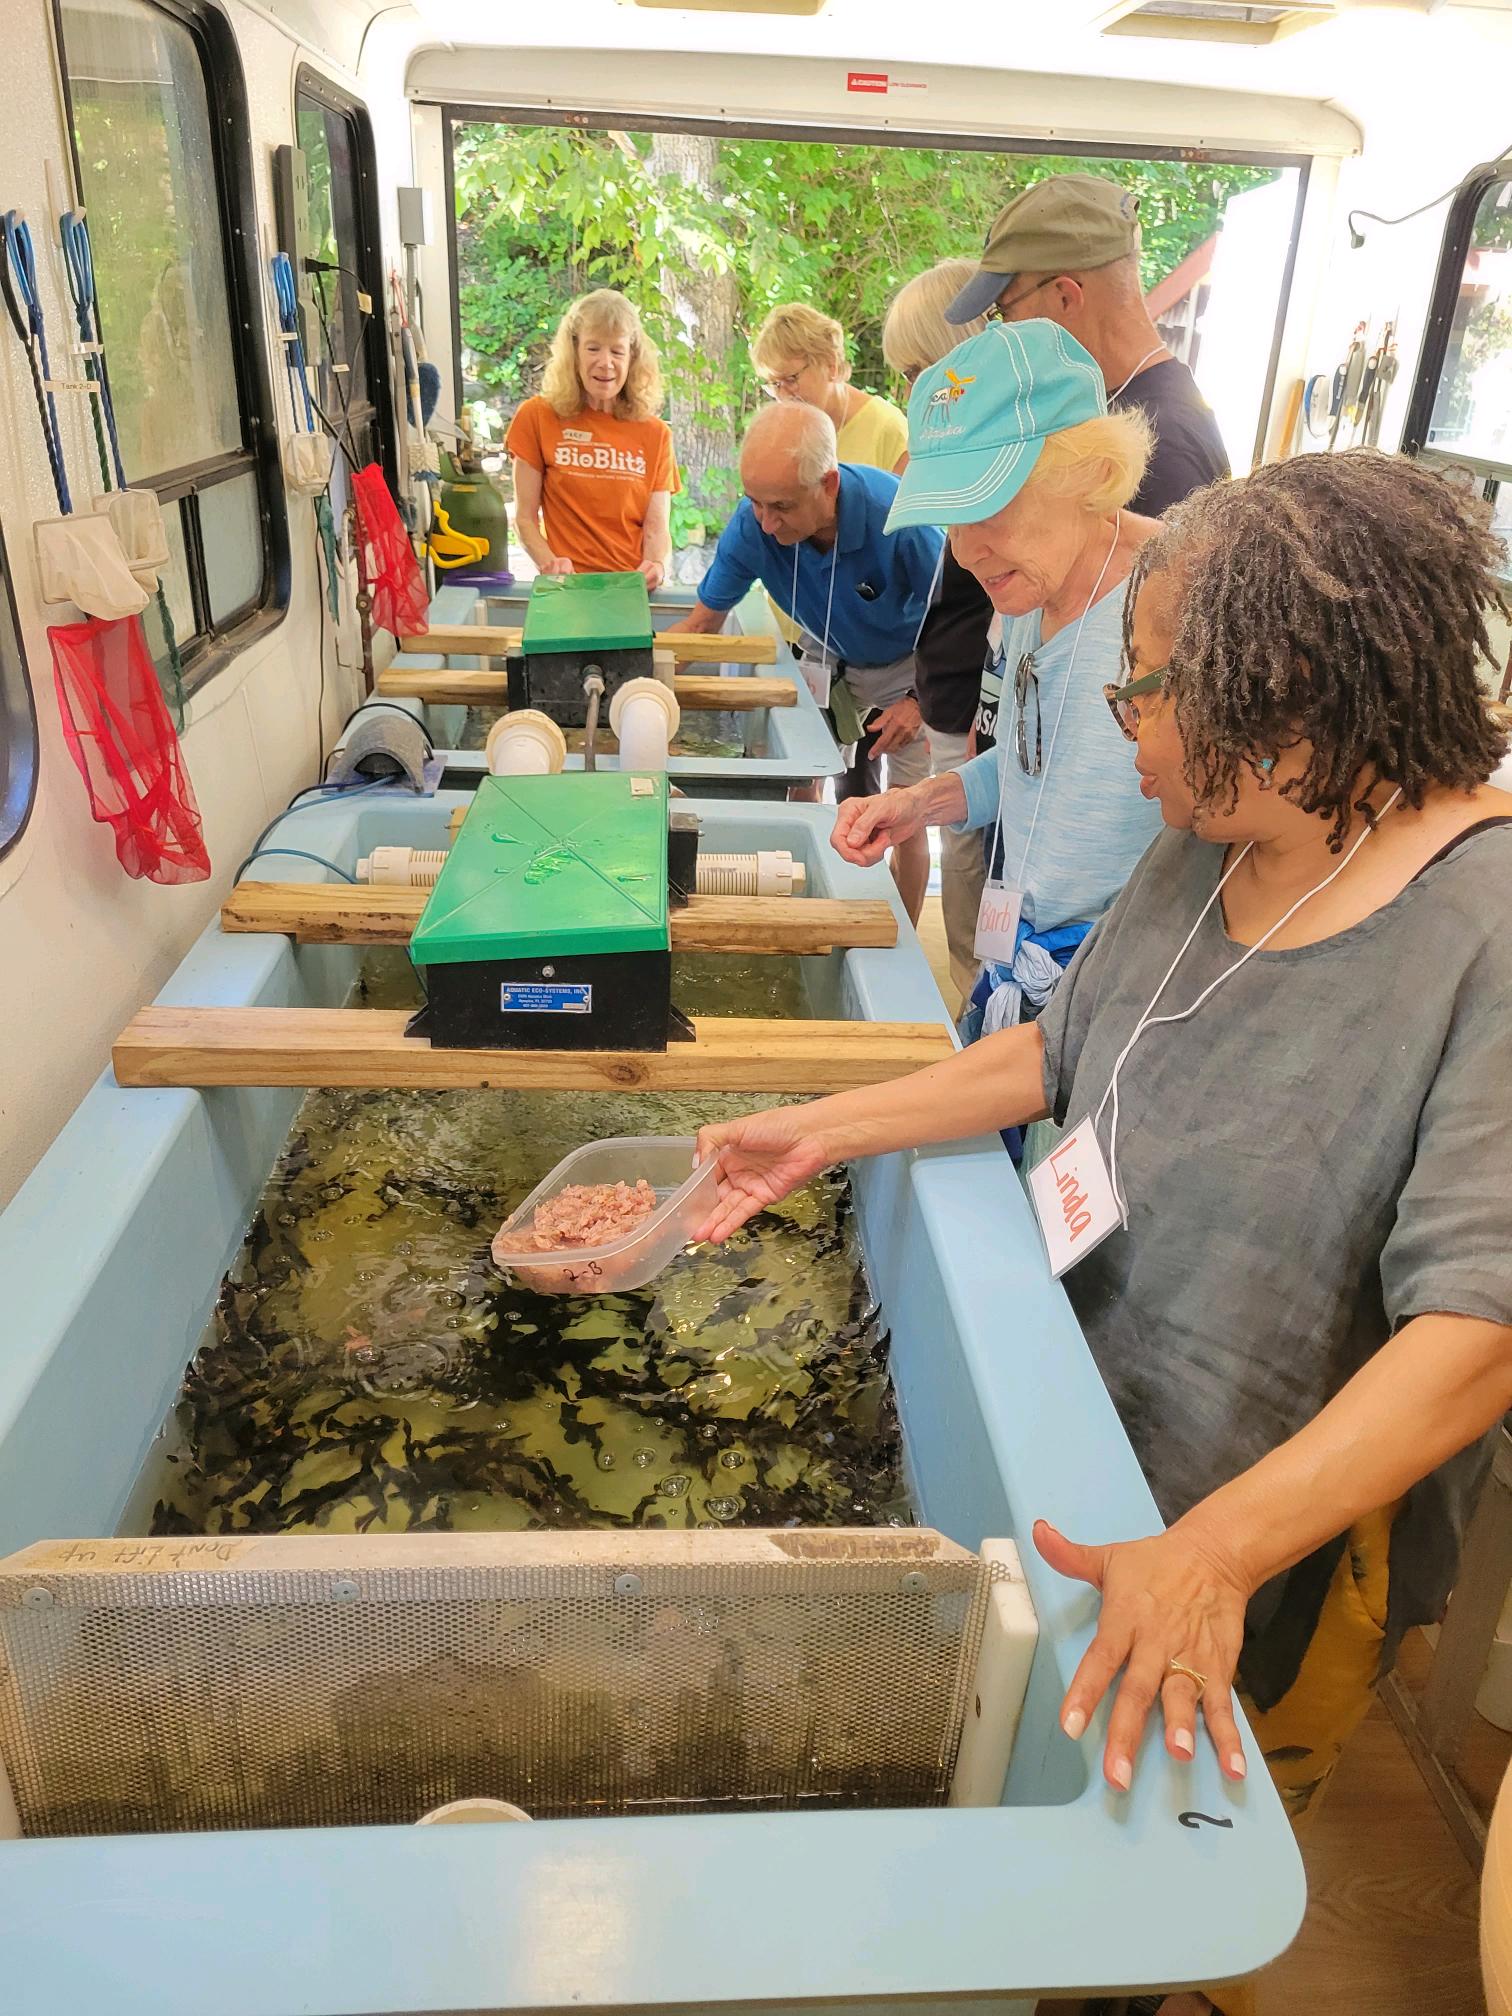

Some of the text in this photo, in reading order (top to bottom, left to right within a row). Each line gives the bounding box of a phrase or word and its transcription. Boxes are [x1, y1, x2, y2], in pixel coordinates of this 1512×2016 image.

[554, 446, 646, 475] BioBlitz
[980, 900, 1011, 933] Barb
[1049, 1137, 1092, 1243] Linda
[1177, 1811, 1234, 1829] 2
